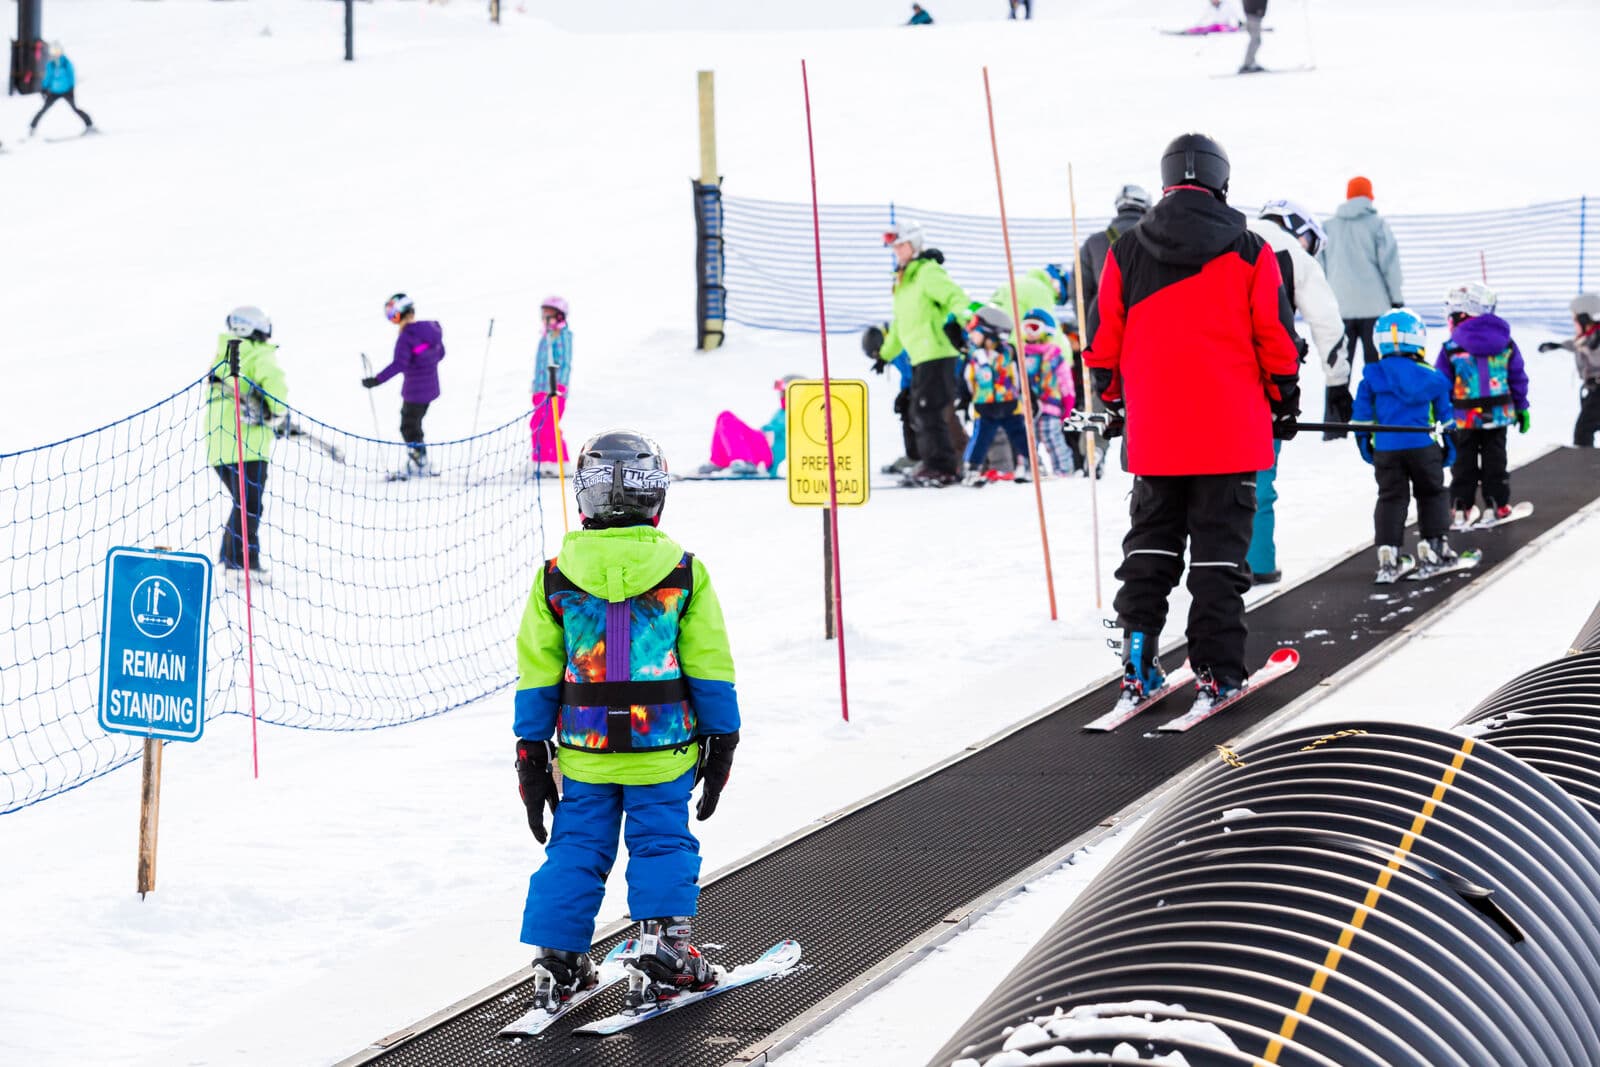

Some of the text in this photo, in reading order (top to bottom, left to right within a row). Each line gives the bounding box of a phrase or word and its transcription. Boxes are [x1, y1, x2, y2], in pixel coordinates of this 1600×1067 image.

[801, 455, 852, 471] PREPRE
[796, 479, 859, 494] TO UNOAD
[122, 648, 186, 682] REMAIN
[110, 689, 193, 725] STANDING
